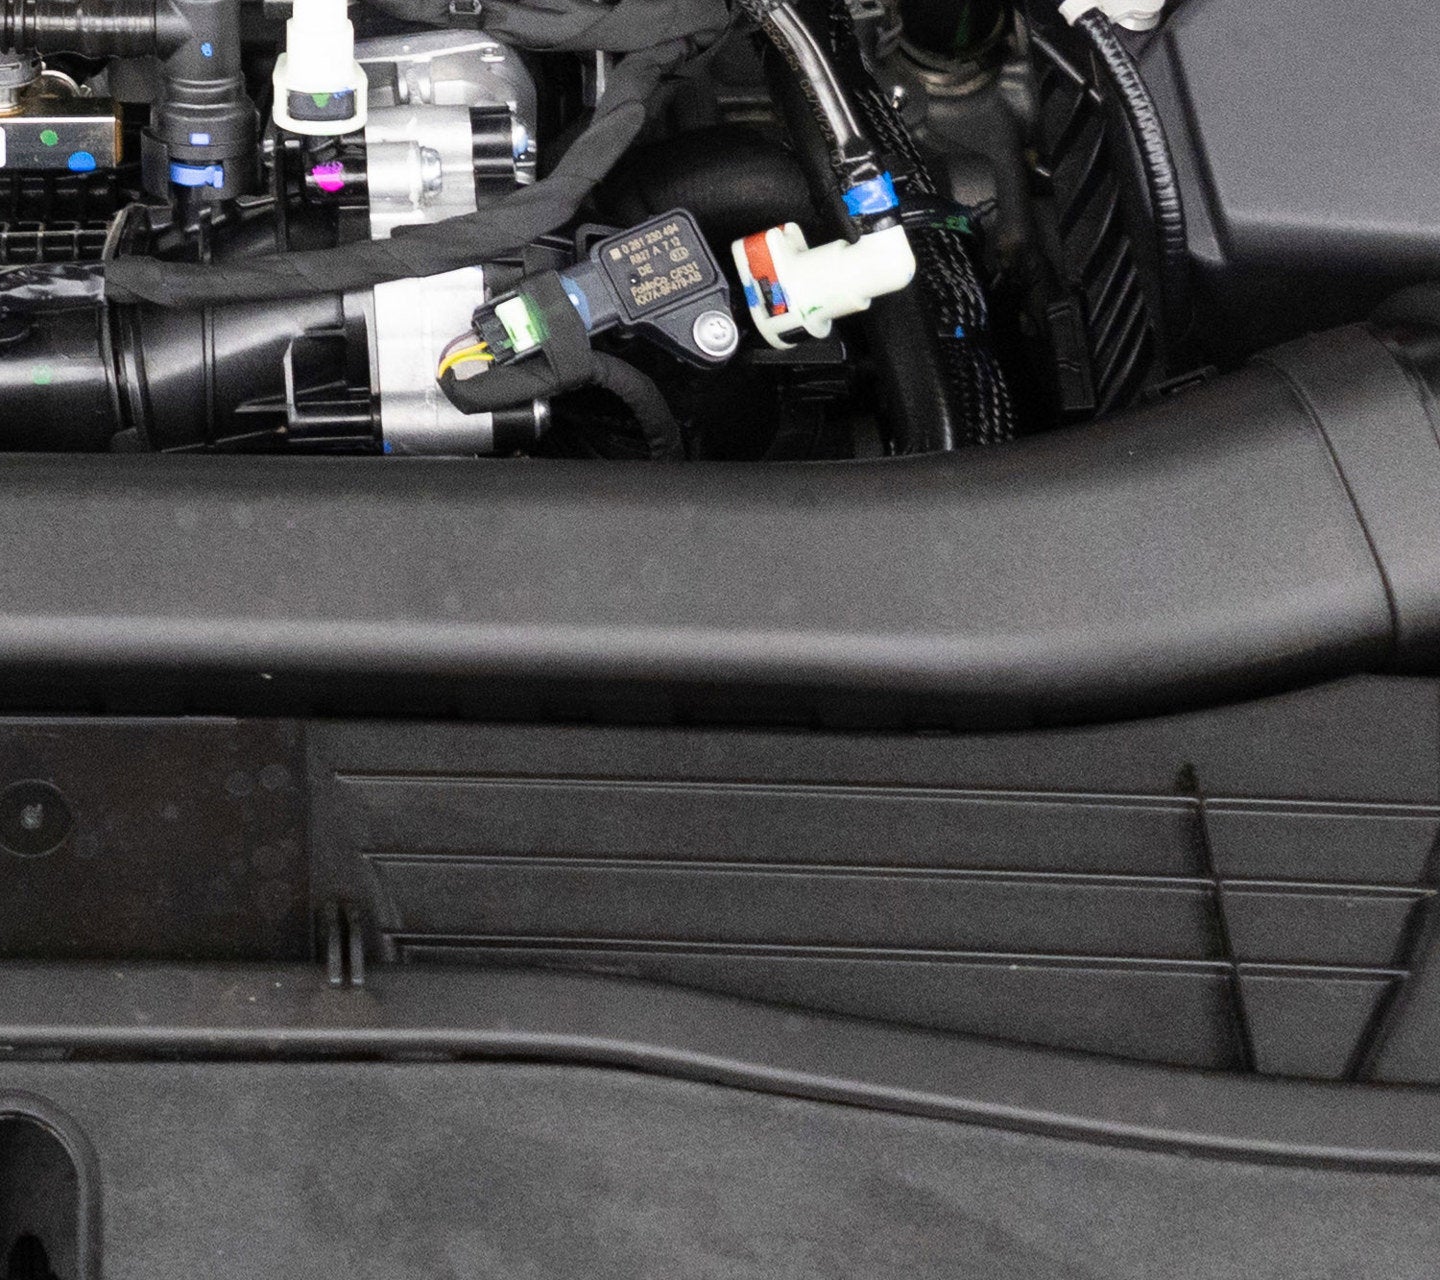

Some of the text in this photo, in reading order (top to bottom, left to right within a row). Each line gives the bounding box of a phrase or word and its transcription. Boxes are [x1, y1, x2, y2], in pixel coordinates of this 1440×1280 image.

[653, 246, 661, 256] A
[637, 263, 654, 277] DE
[630, 276, 668, 297] FoMoCo
